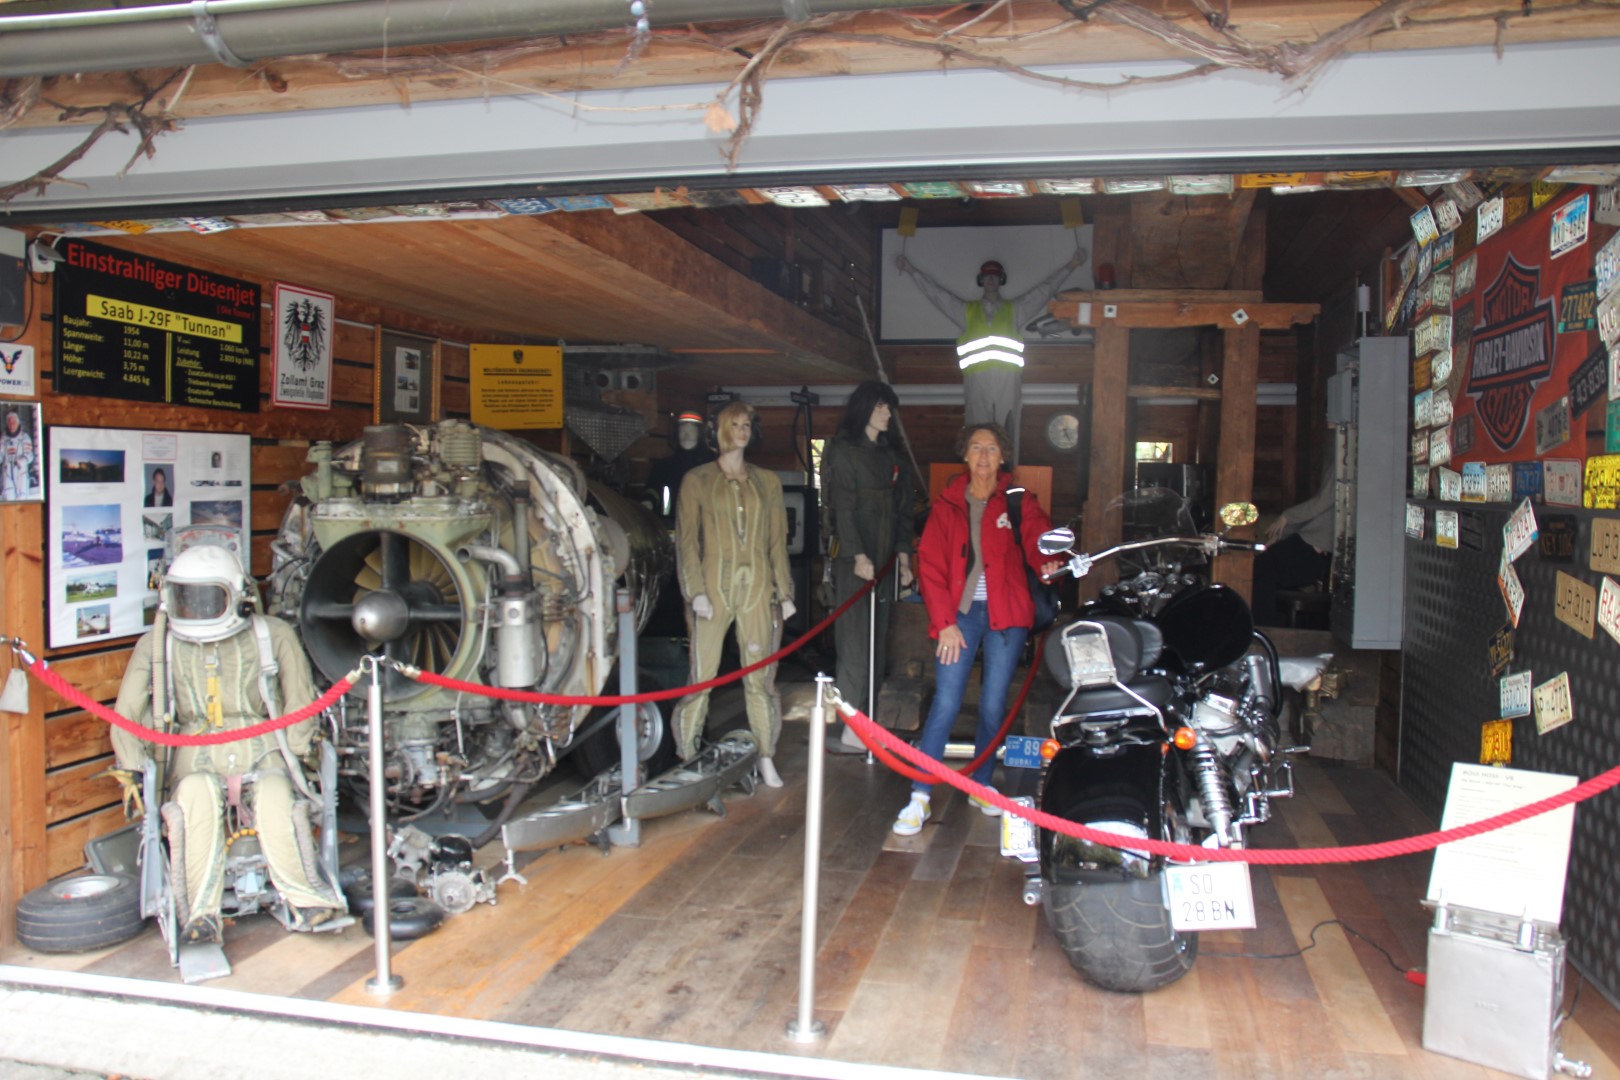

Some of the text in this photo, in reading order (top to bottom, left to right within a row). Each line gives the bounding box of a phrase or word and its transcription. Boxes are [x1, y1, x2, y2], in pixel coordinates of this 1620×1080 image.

[67, 243, 256, 307] Einstrahliger Düsenjet
[101, 301, 232, 338] Saab J-29F "Tunnan"
[123, 325, 140, 336] 1954
[1472, 320, 1547, 379] HARLEY-DAVIDSON
[281, 372, 325, 390] Zollamt Graz
[1024, 740, 1040, 757] 89
[1008, 757, 1032, 766] DUBAI
[1190, 873, 1214, 896] SO
